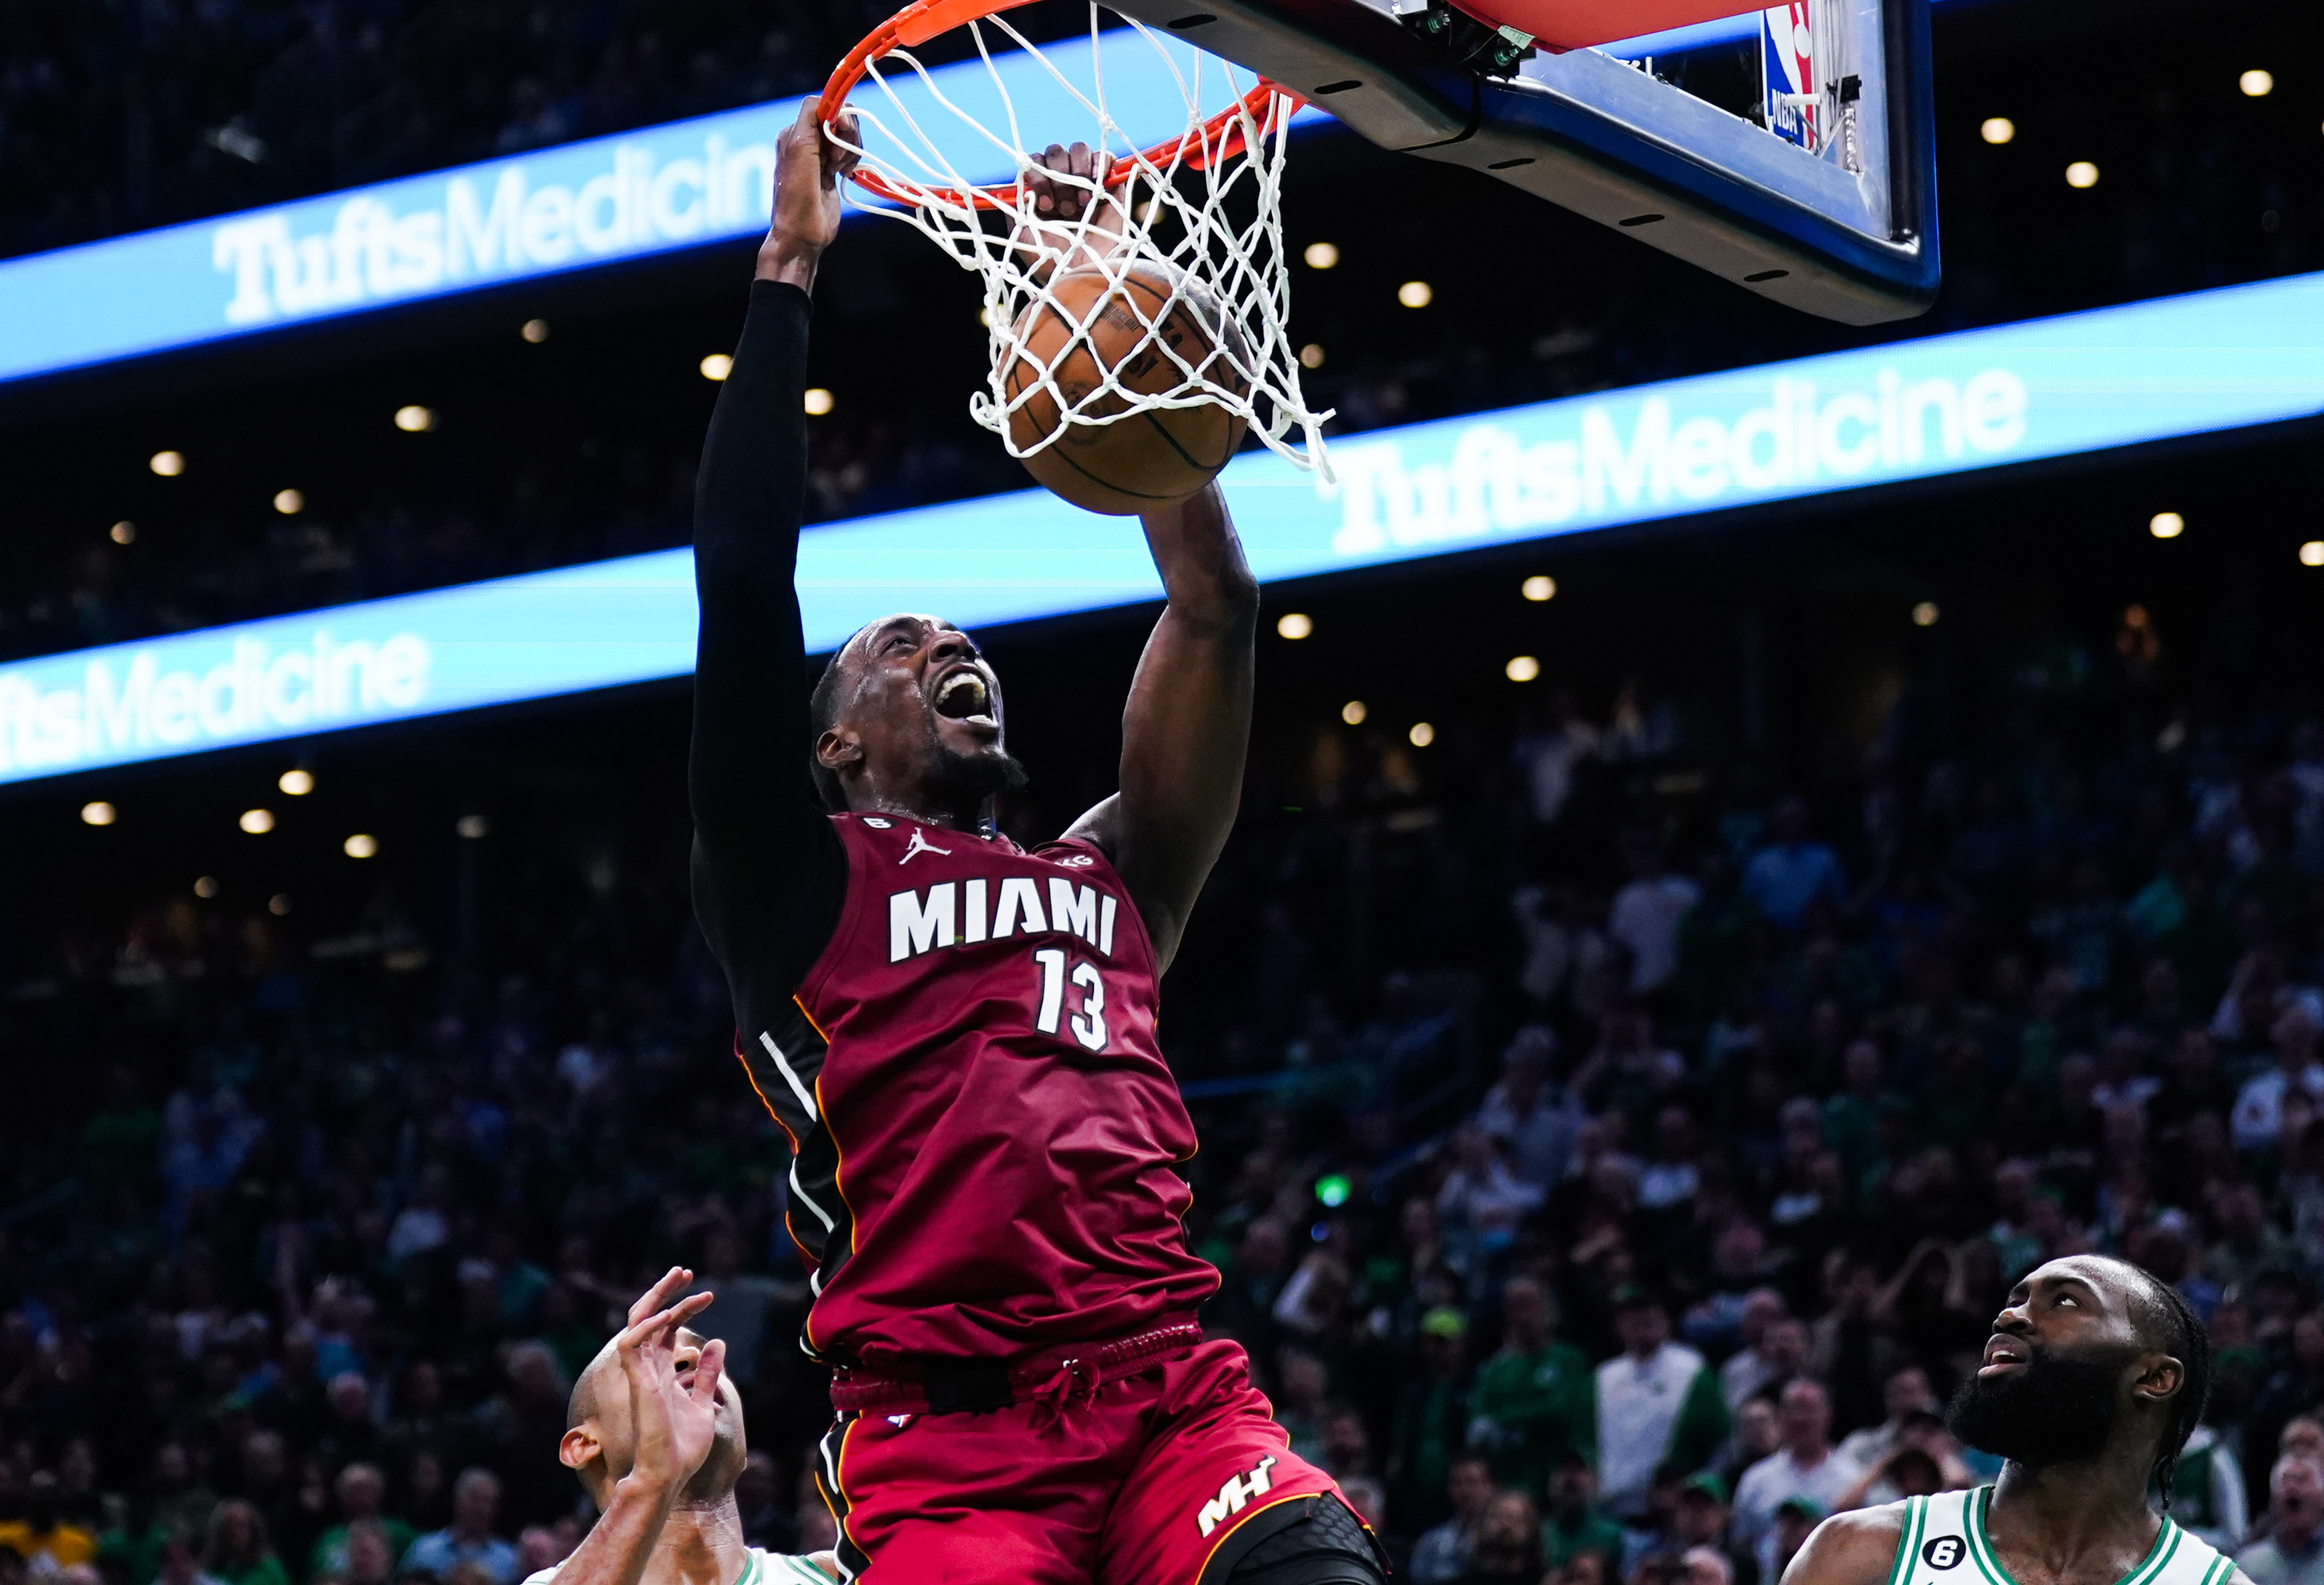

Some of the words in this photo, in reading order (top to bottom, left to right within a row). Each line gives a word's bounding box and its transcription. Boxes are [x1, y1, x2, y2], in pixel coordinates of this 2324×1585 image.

[1772, 88, 1798, 135] NBA
[212, 134, 777, 324] TuftsMedicin
[889, 877, 1117, 963] MIAMI
[1034, 948, 1109, 1052] 13
[1930, 1539, 1958, 1567] 6
